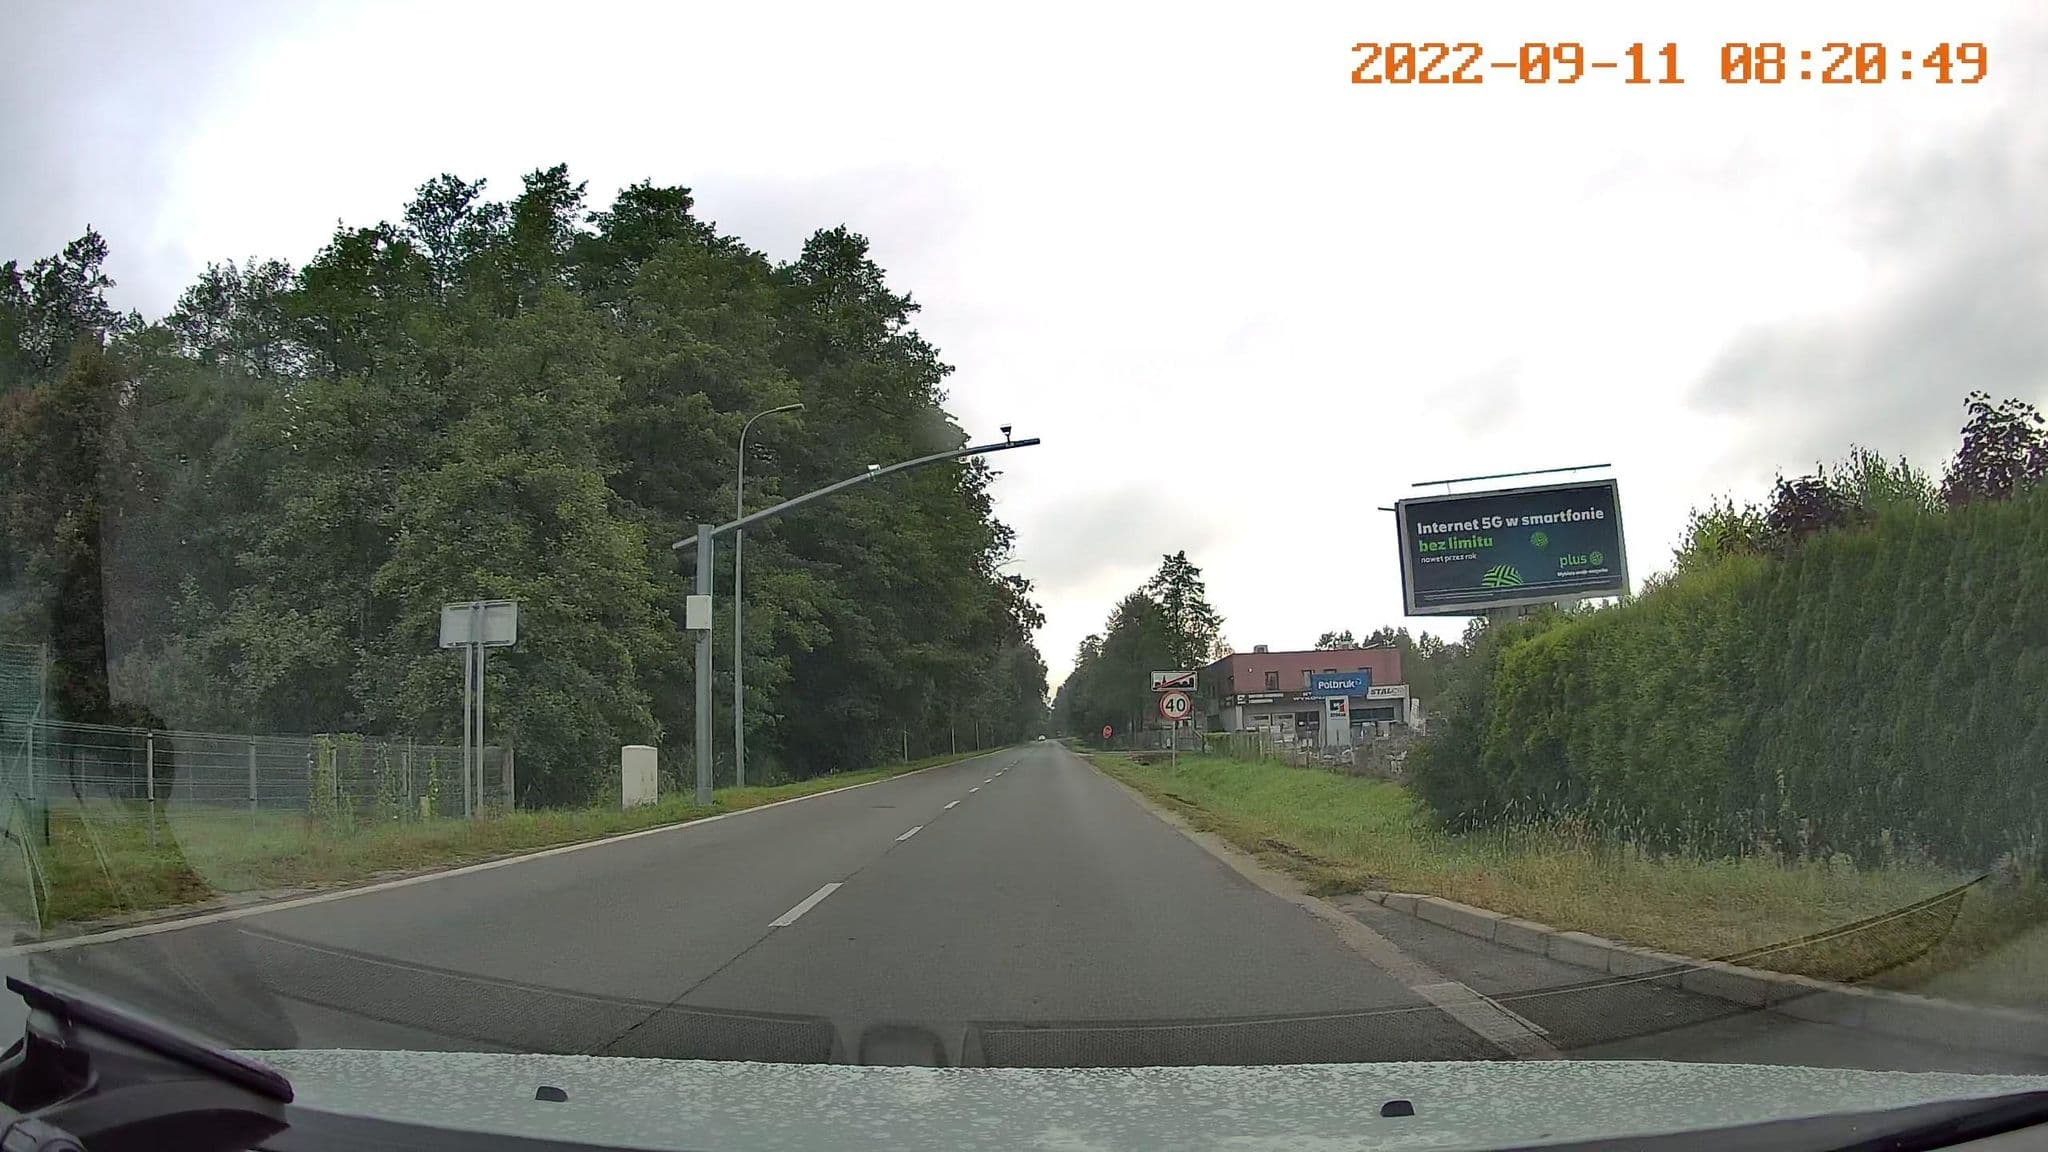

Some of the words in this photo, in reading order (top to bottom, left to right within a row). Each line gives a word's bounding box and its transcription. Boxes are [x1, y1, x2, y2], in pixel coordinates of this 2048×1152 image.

[1417, 519, 1479, 535] Internet
[1482, 516, 1503, 530] 5G
[1506, 517, 1520, 527] w
[1522, 507, 1605, 526] smartfonie
[1418, 540, 1446, 552] bez
[1448, 535, 1493, 549] limitu
[1445, 554, 1464, 563] przez
[1465, 552, 1477, 560] rok
[1560, 553, 1587, 568] plus
[1318, 679, 1356, 690] Polbruk
[1165, 697, 1186, 713] 40
